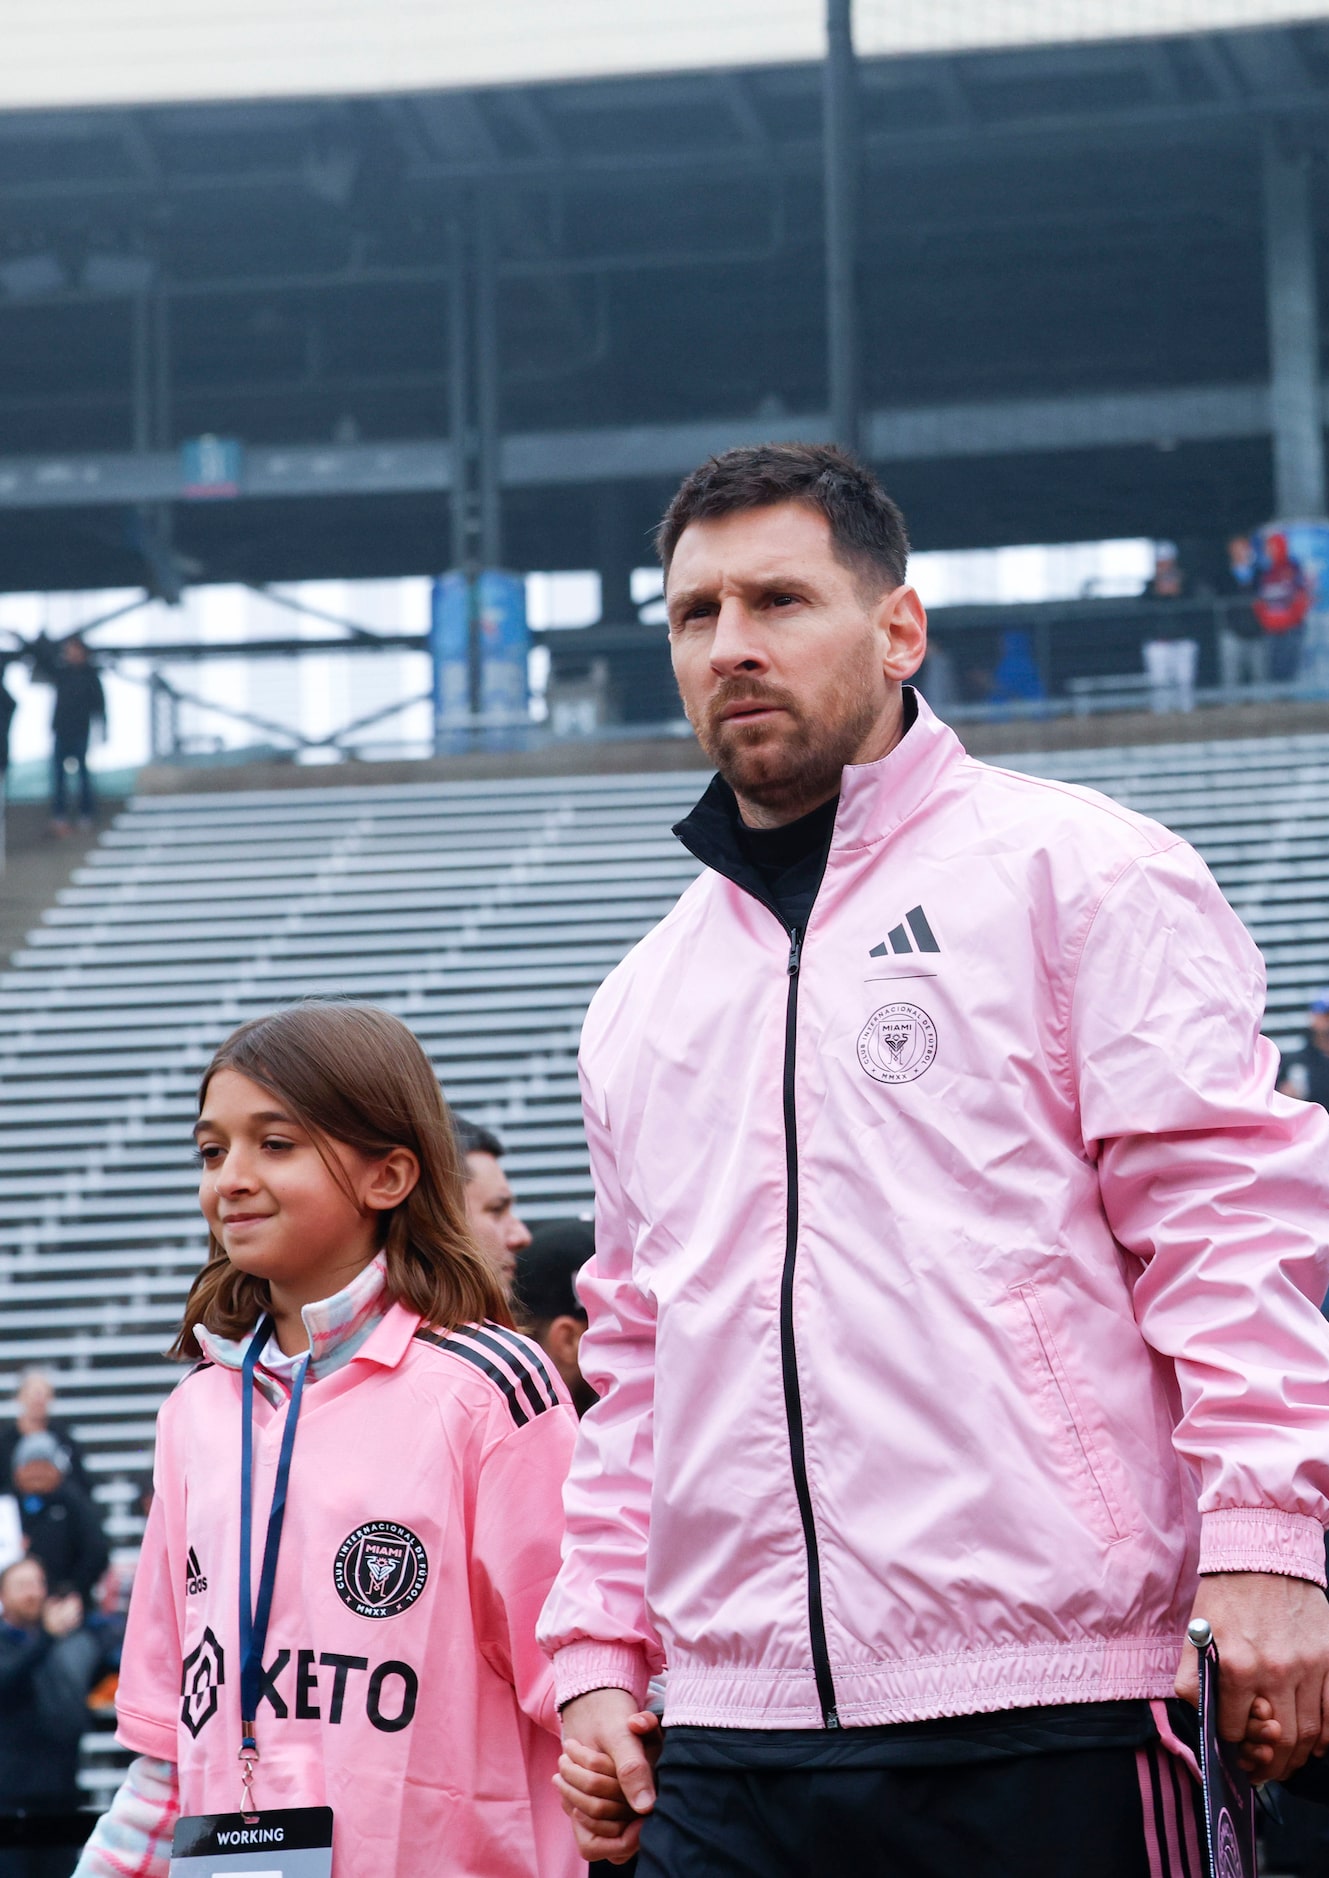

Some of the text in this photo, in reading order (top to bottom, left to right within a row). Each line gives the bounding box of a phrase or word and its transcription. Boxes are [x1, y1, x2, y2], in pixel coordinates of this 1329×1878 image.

[862, 1006, 922, 1040] INTERNACIONAL
[882, 1024, 912, 1032] MIAMI
[881, 1072, 907, 1081] MMXX
[338, 1522, 416, 1558] INTERNACIONAL
[365, 1543, 403, 1558] MIAMI
[414, 1545, 425, 1560] DE
[335, 1561, 345, 1590] CLUB
[185, 1576, 208, 1597] idas
[355, 1603, 388, 1617] MMXX
[217, 1827, 285, 1845] WORKING
